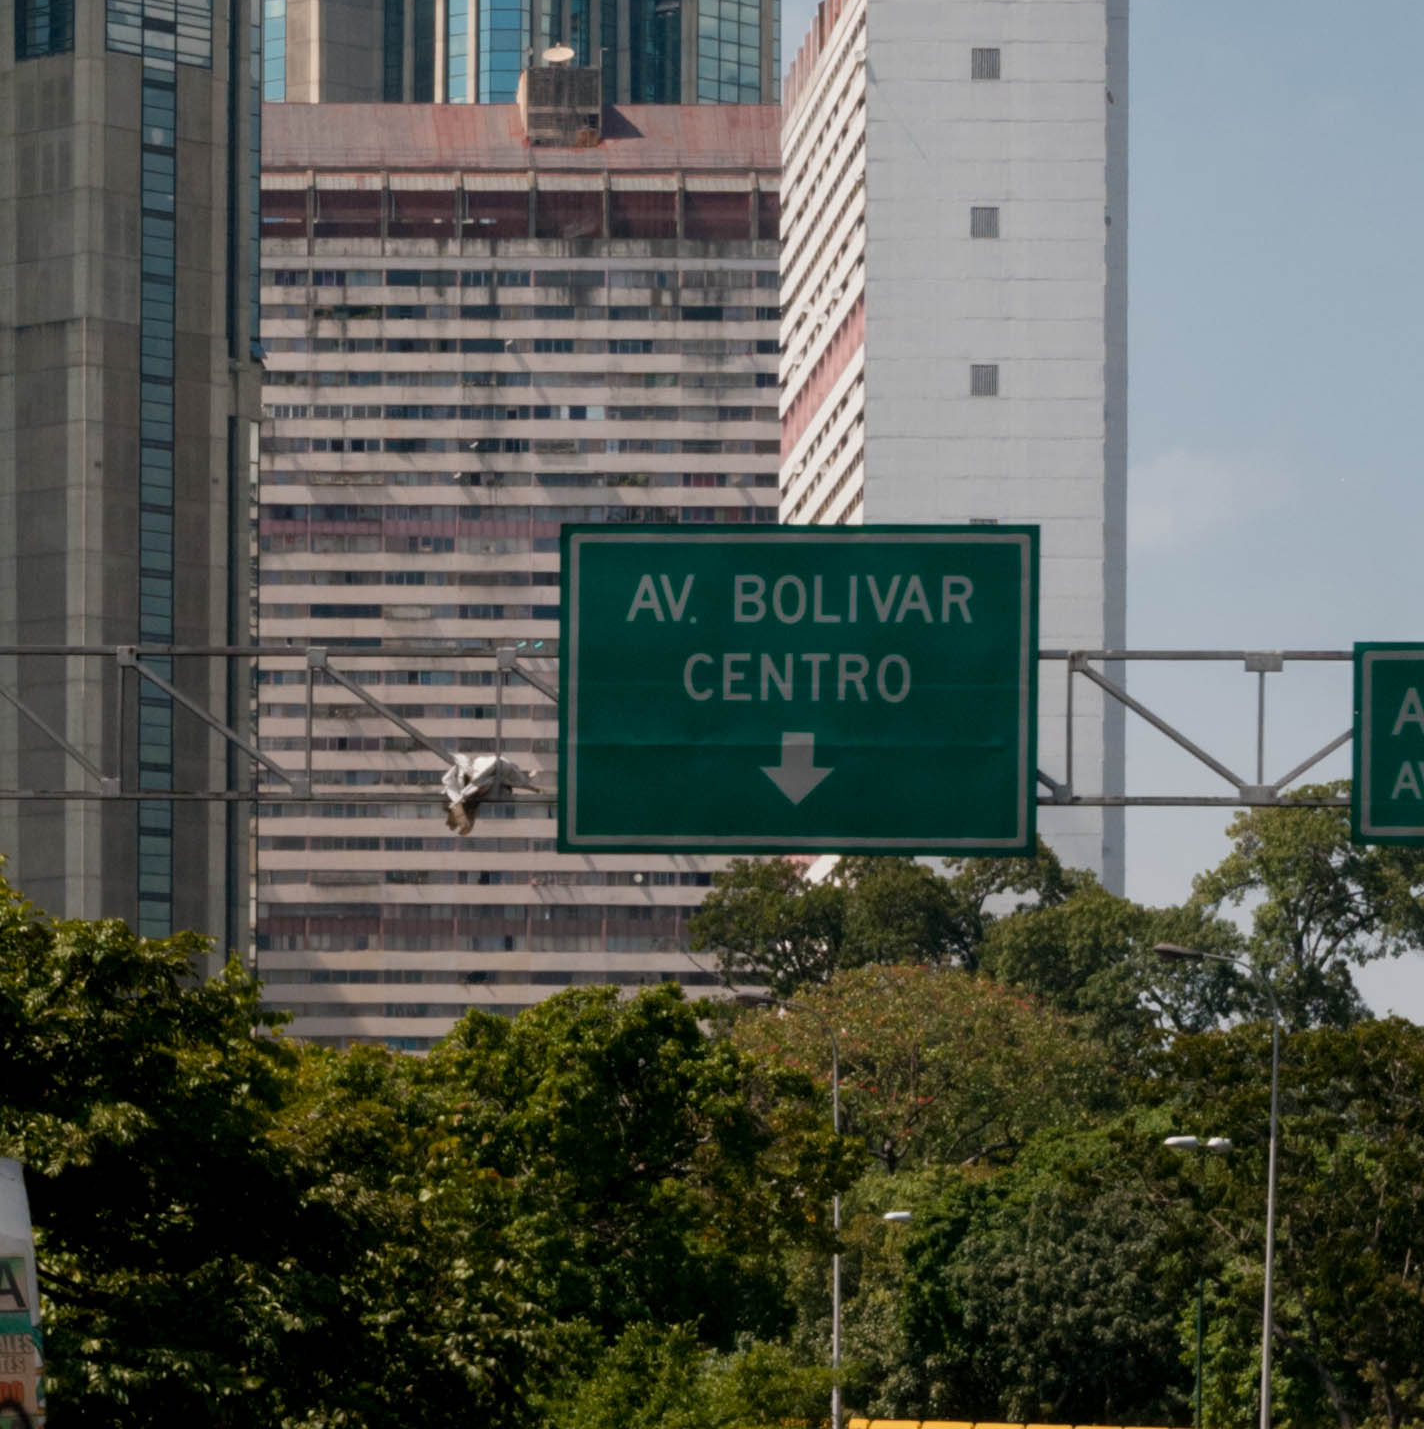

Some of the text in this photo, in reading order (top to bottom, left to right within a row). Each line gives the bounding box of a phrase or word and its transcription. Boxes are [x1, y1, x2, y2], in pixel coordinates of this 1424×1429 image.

[626, 574, 974, 624] AV. BOLIVAR
[683, 652, 911, 703] CENTRO
